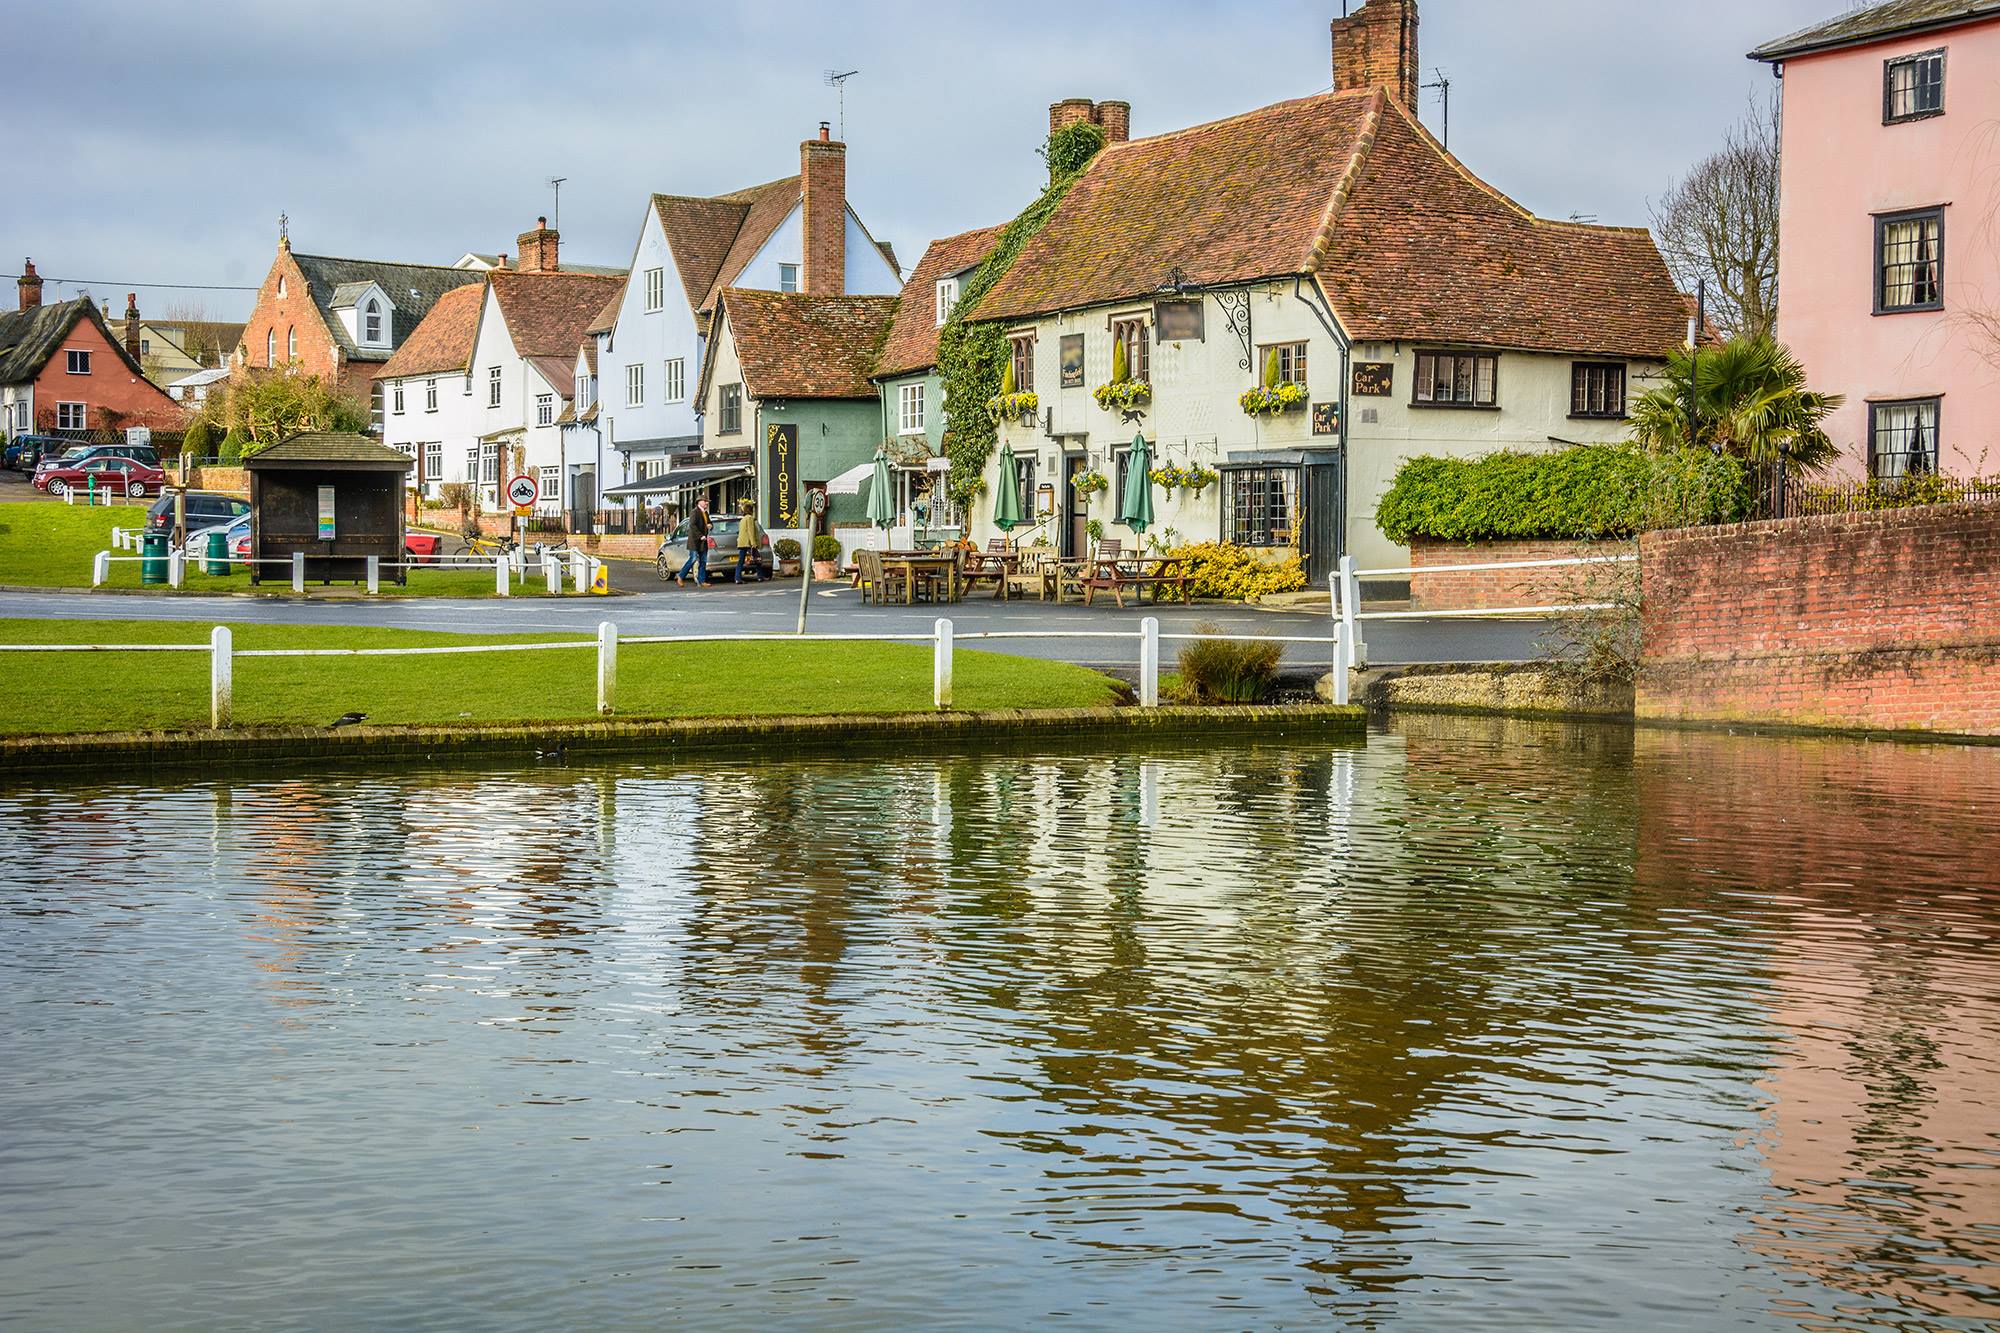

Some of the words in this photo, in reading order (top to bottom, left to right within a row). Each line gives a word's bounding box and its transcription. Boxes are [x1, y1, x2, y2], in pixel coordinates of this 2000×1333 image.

[1355, 371, 1374, 382] Car
[1355, 383, 1380, 393] Park
[1314, 412, 1326, 421] Car
[1314, 423, 1331, 432] Park
[778, 433, 788, 510] ANTIQUES
